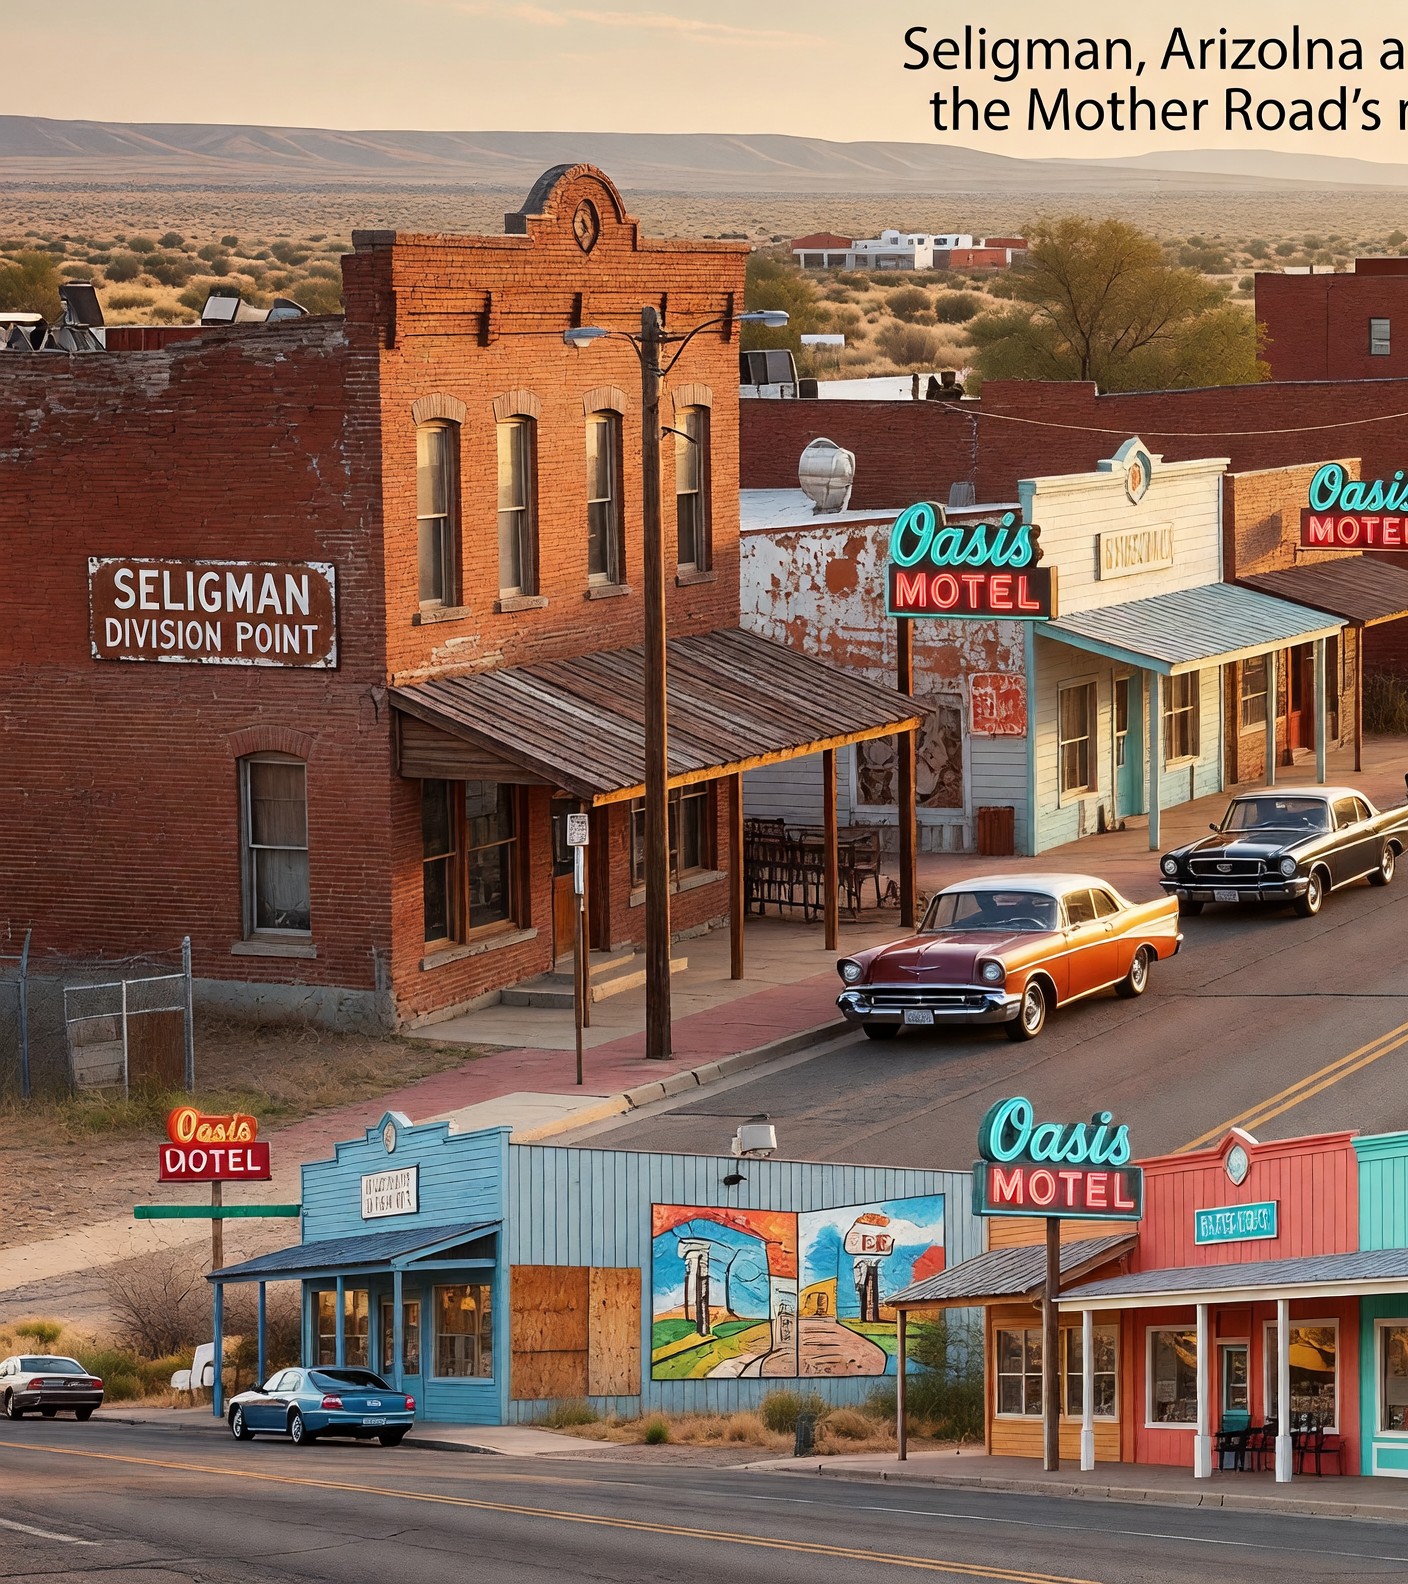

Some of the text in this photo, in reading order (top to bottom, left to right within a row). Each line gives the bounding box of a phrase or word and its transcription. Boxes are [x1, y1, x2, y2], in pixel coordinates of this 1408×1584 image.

[889, 502, 1033, 568] Oasis
[113, 567, 310, 616] SELIGMAN
[896, 572, 1040, 610] MOTEL
[105, 617, 319, 655] DIVISION POINT
[989, 1096, 1131, 1166] Oasis
[993, 1168, 1135, 1209] MOTEL
